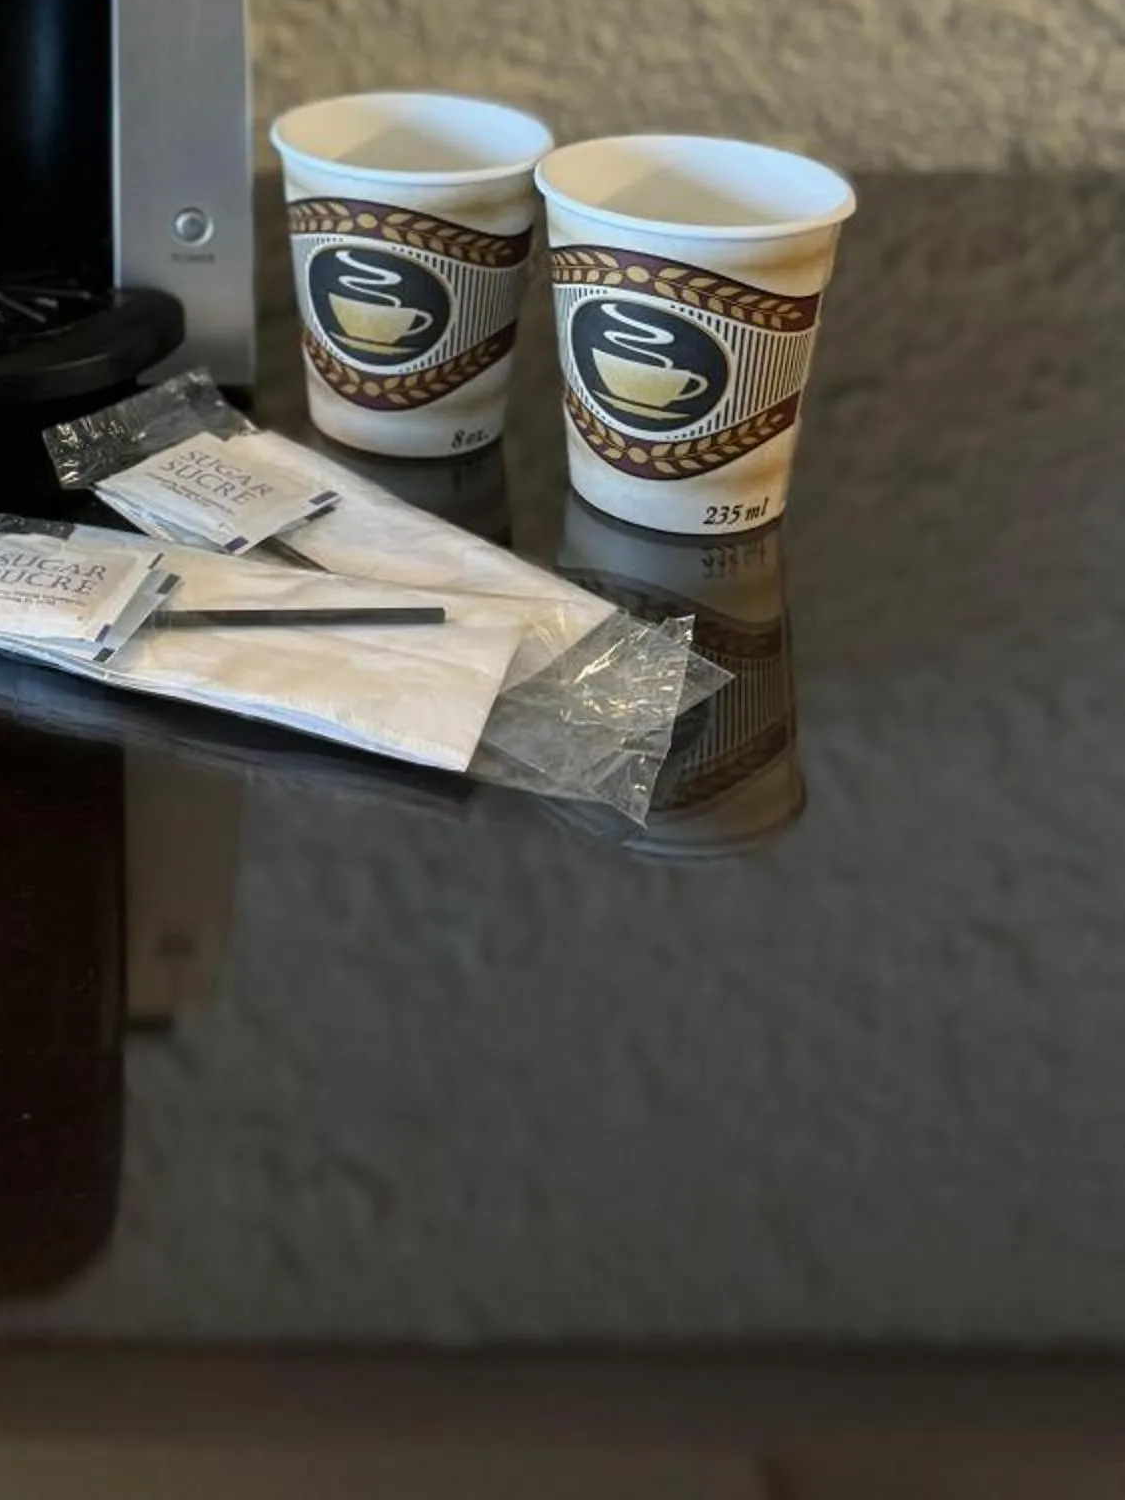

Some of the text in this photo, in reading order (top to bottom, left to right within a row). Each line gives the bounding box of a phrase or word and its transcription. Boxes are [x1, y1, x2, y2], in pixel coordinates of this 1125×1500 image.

[451, 429, 467, 448] 8
[158, 460, 258, 505] SUCRE
[179, 450, 275, 496] SUGAR
[703, 496, 770, 525] 235 ml
